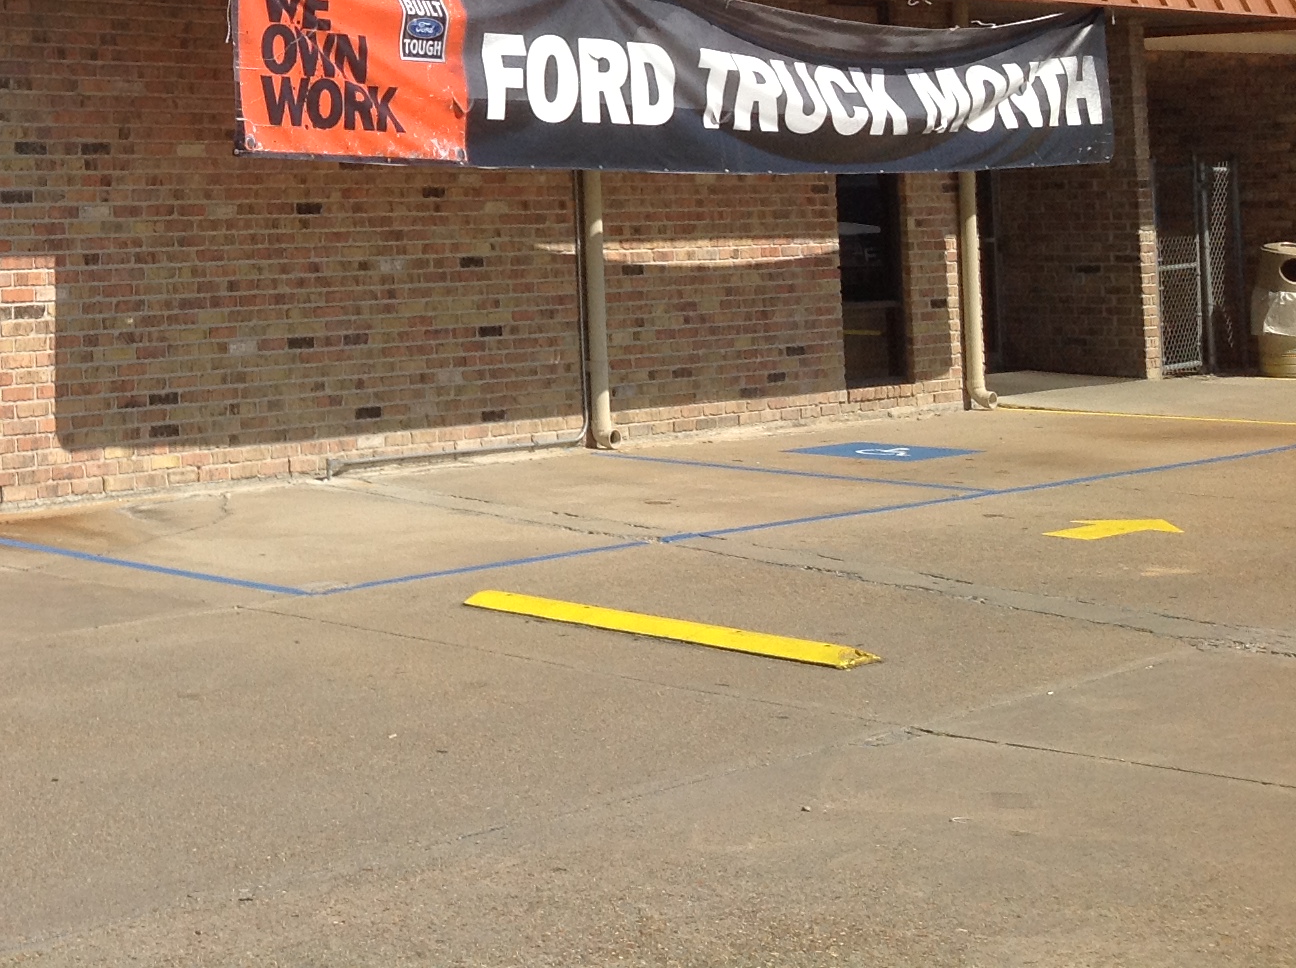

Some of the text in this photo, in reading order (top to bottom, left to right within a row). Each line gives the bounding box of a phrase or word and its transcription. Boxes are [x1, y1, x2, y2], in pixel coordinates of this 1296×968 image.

[261, 23, 368, 84] OWN
[403, 38, 442, 56] TOUGH
[260, 74, 406, 133] WORK
[481, 33, 1103, 136] FORD TRUCK MONTH
